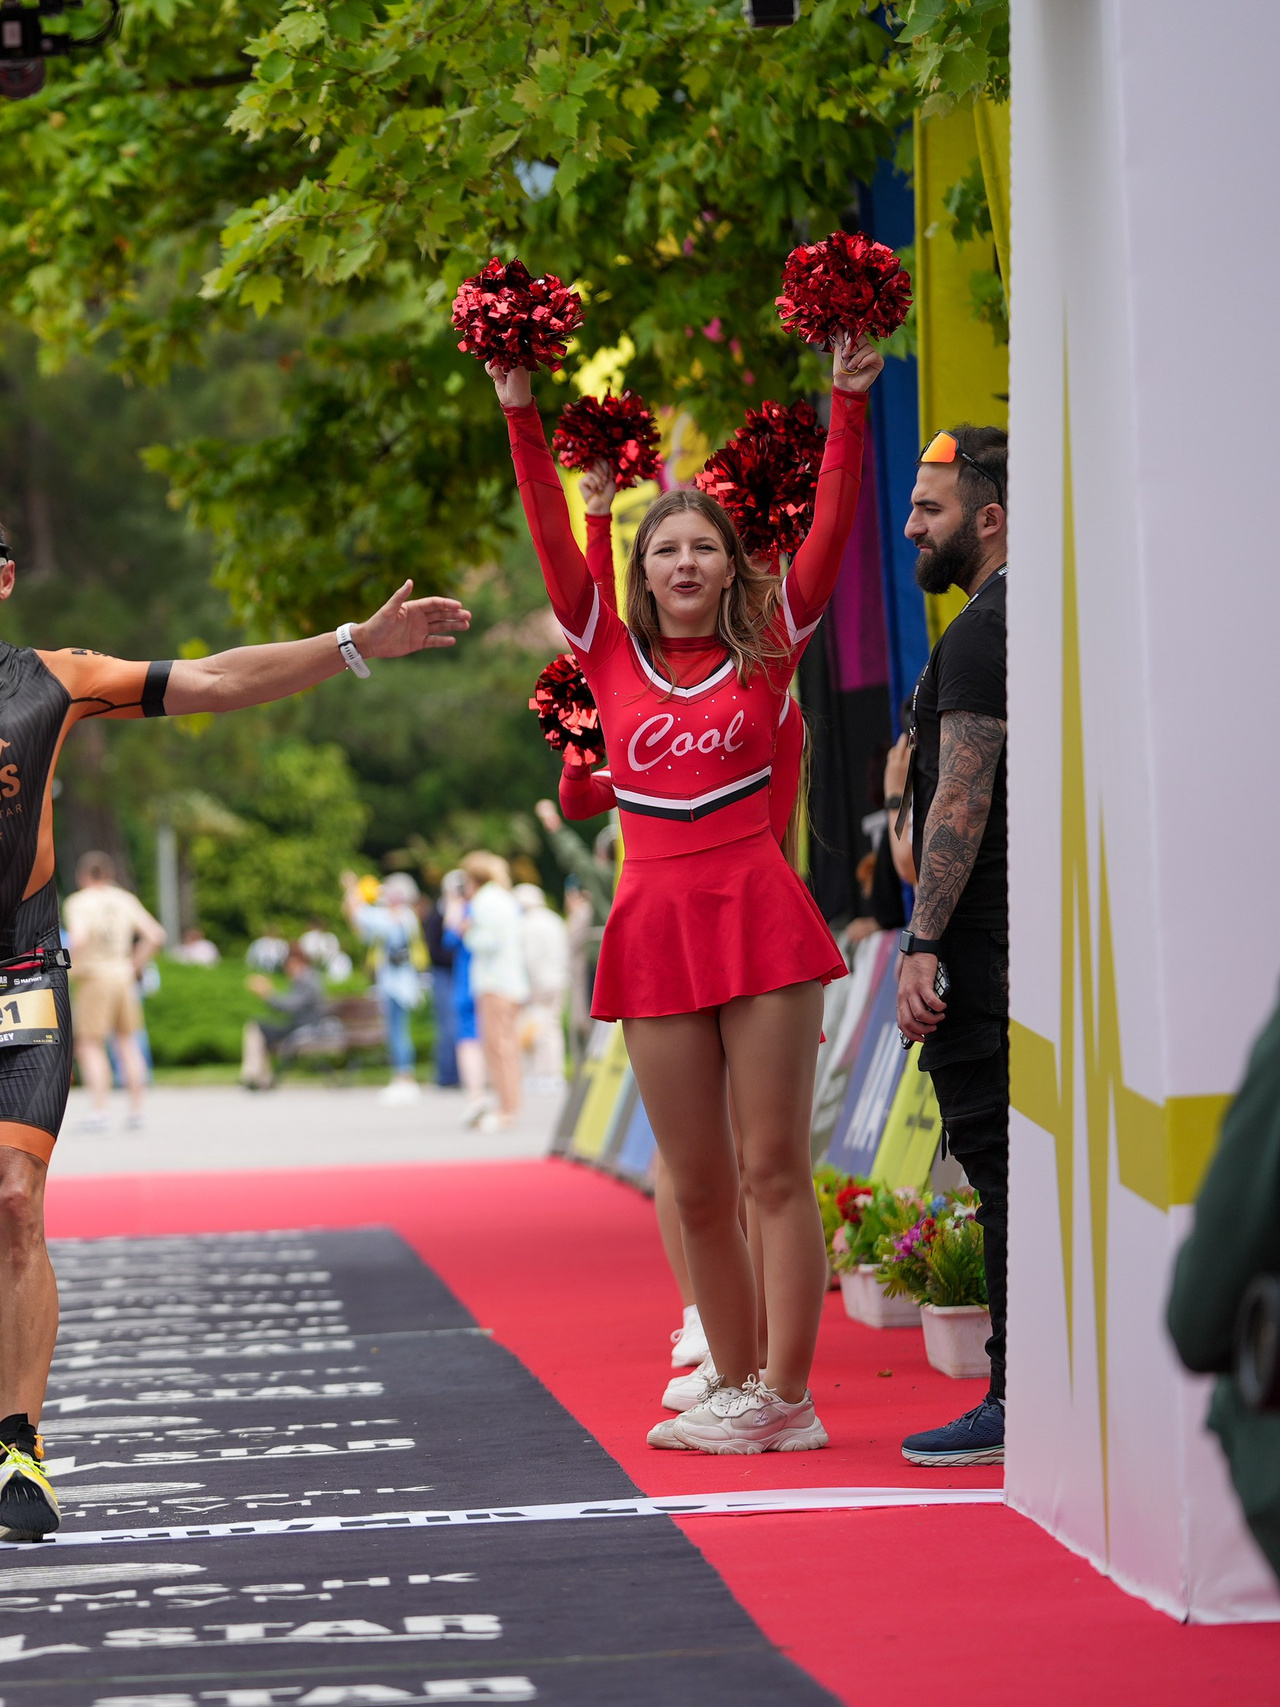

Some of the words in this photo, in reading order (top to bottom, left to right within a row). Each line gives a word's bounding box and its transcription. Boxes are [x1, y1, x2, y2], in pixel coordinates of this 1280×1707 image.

[627, 709, 745, 772] Cool
[132, 1438, 416, 1461] STAR
[102, 1614, 502, 1647] STAR
